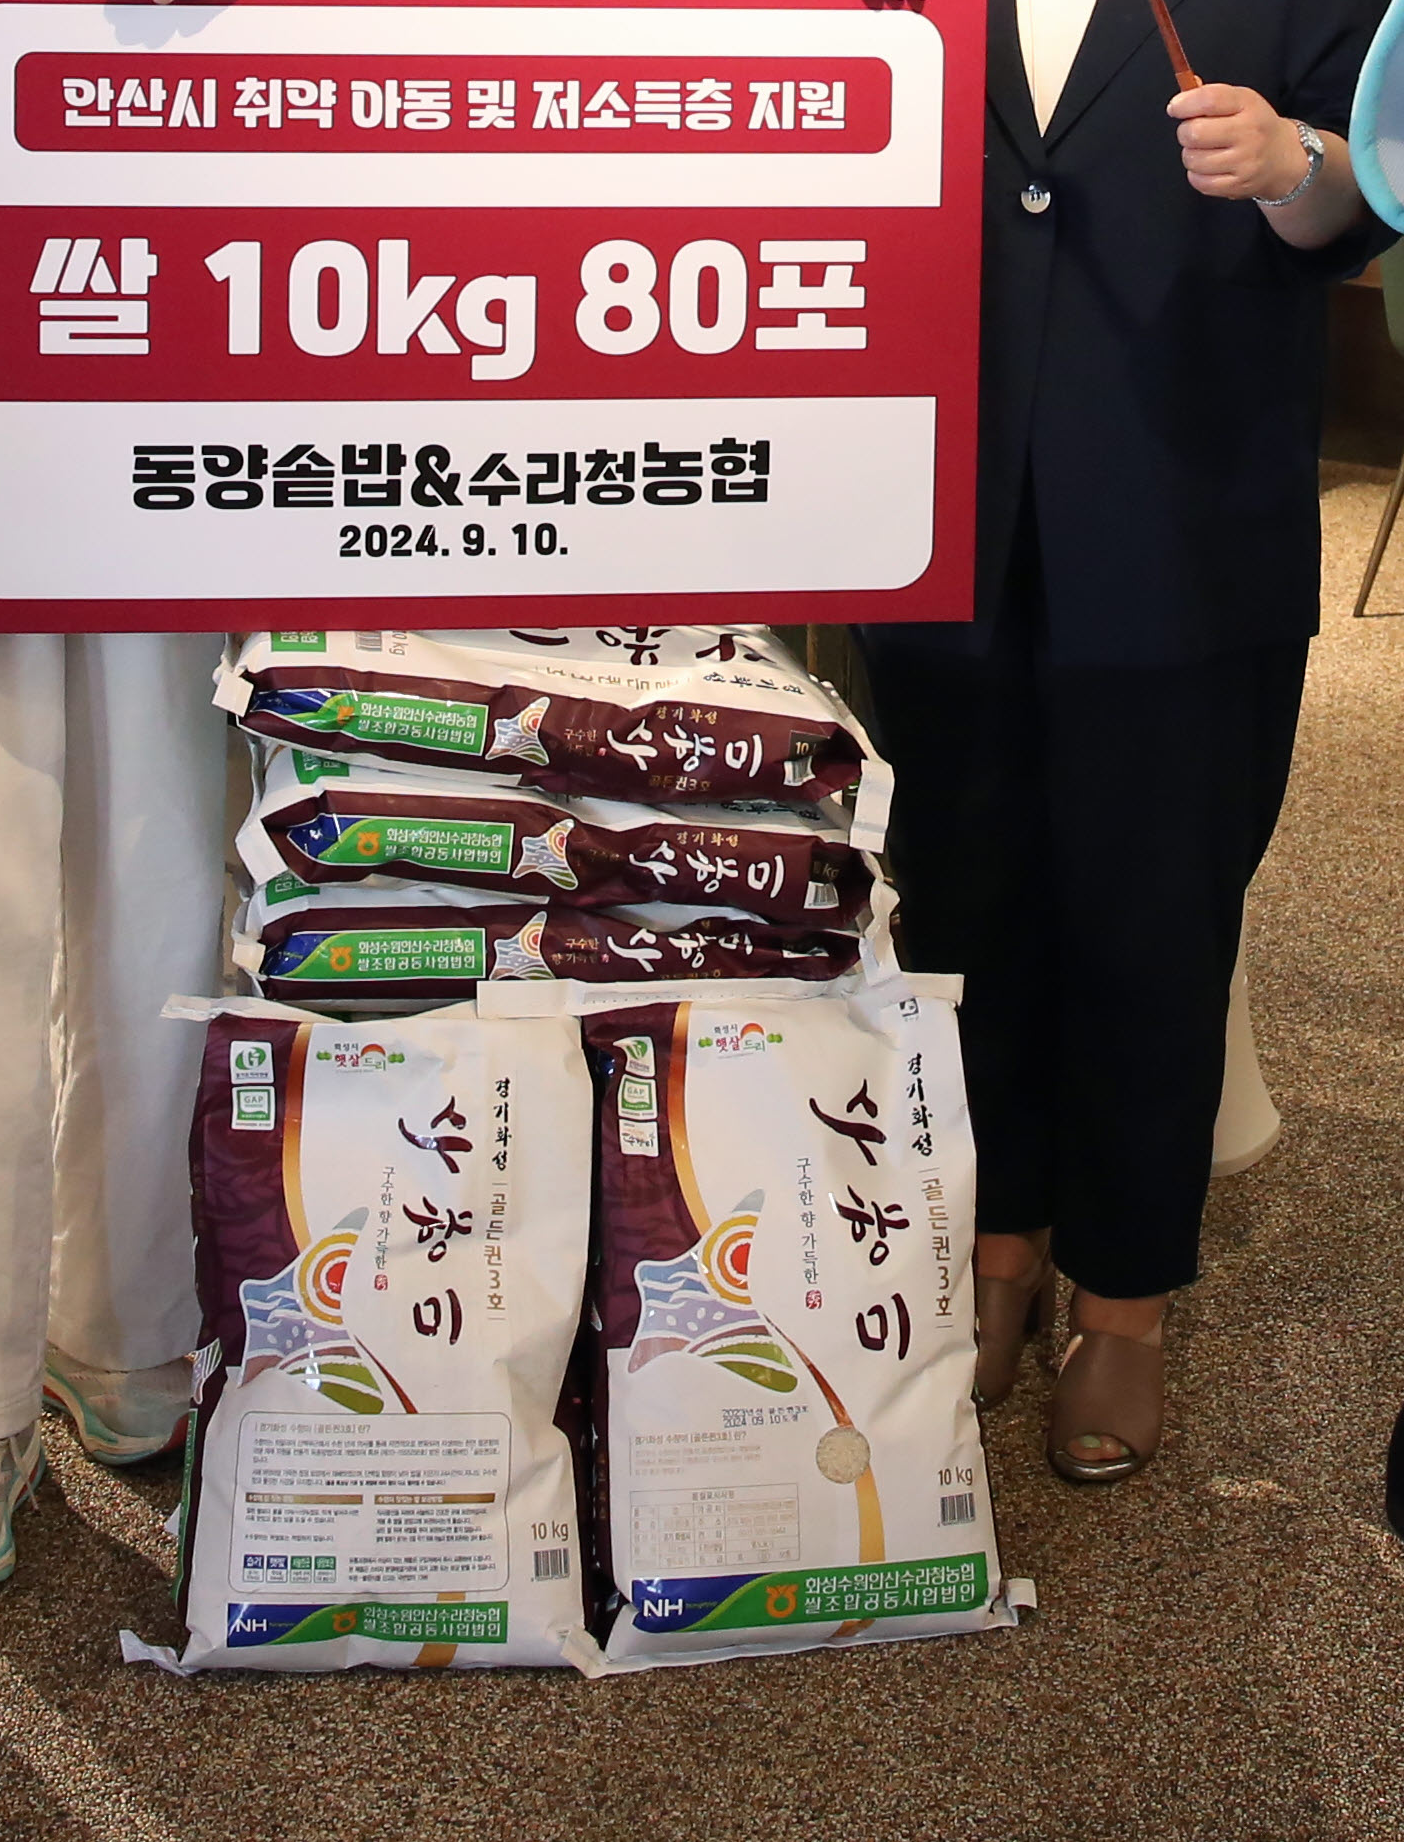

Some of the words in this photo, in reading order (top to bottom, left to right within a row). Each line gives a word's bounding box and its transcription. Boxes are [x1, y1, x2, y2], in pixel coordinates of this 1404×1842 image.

[61, 77, 217, 129] 안산시
[232, 78, 337, 129] 취약
[350, 79, 452, 131] 아동
[467, 80, 517, 132] 및
[531, 80, 733, 132] 저소득층
[747, 80, 846, 132] 지원
[28, 237, 158, 356] 쌀
[204, 239, 537, 381] 10kg
[575, 238, 868, 357] 80포
[131, 437, 772, 512] 동양솥밥&수라청농협
[339, 524, 450, 559] 2024.
[462, 524, 503, 558] 9.
[512, 523, 569, 558] 10.
[606, 718, 763, 778] 수향미
[629, 840, 785, 899] 수향미
[244, 1095, 264, 1104] GAP
[492, 1078, 511, 1171] 경기화성
[906, 1053, 933, 1158] 경기화성
[381, 1167, 395, 1206] 구수한
[796, 1158, 813, 1206] 구수한
[379, 1210, 391, 1224] 향
[398, 1095, 474, 1345] 수향미
[800, 1211, 815, 1228] 향
[809, 1078, 911, 1360] 수향미
[375, 1228, 390, 1270] 가득한
[483, 1193, 507, 1311] 골든퀸3호
[801, 1232, 818, 1284] 가득한
[921, 1178, 952, 1317] 골든퀸3호
[938, 1468, 952, 1485] 10
[956, 1467, 973, 1485] kg
[531, 1522, 547, 1541] 10
[552, 1521, 569, 1541] kg
[804, 1584, 976, 1614] 쌀조합공동사업법인
[806, 1563, 975, 1595] 화성수원안산수라청농협
[643, 1598, 683, 1617] NH
